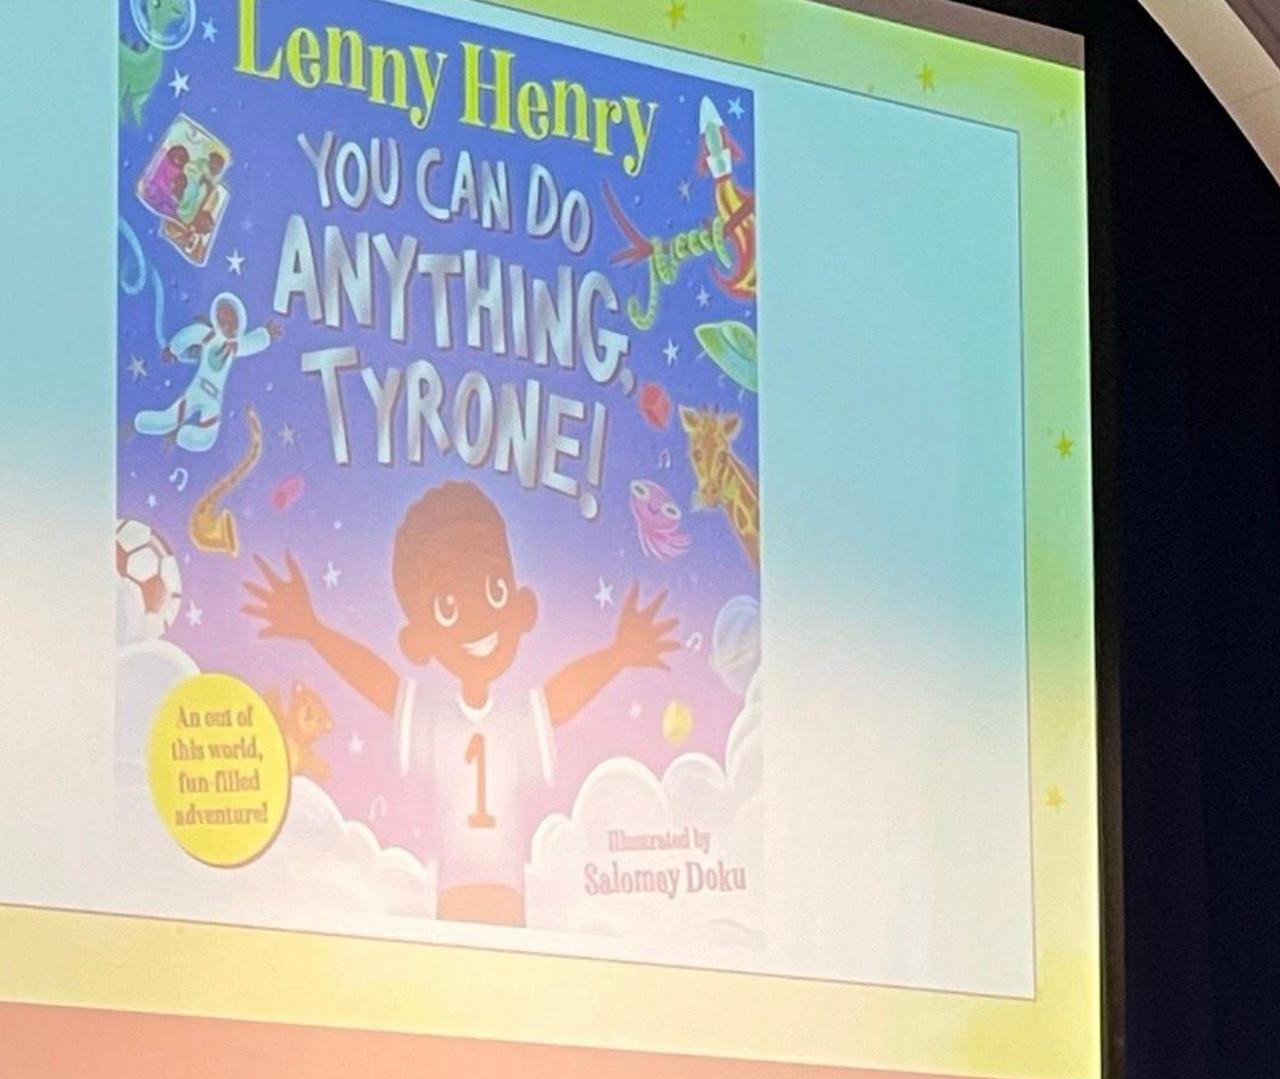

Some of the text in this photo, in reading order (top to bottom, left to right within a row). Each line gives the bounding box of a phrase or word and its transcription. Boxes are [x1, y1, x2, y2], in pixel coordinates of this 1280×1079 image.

[234, 0, 660, 178] Lenny Henry
[297, 131, 592, 255] YOU CAN DO
[272, 213, 636, 398] ANYTHING,
[301, 345, 606, 521] TYRONE!
[176, 704, 254, 729] An out of
[171, 736, 264, 762] this world,
[178, 768, 261, 794] fun-filled
[464, 733, 497, 828] 1
[175, 801, 269, 826] adventure!
[608, 826, 711, 854] Illustrated by
[584, 859, 747, 900] Salomey Doku
